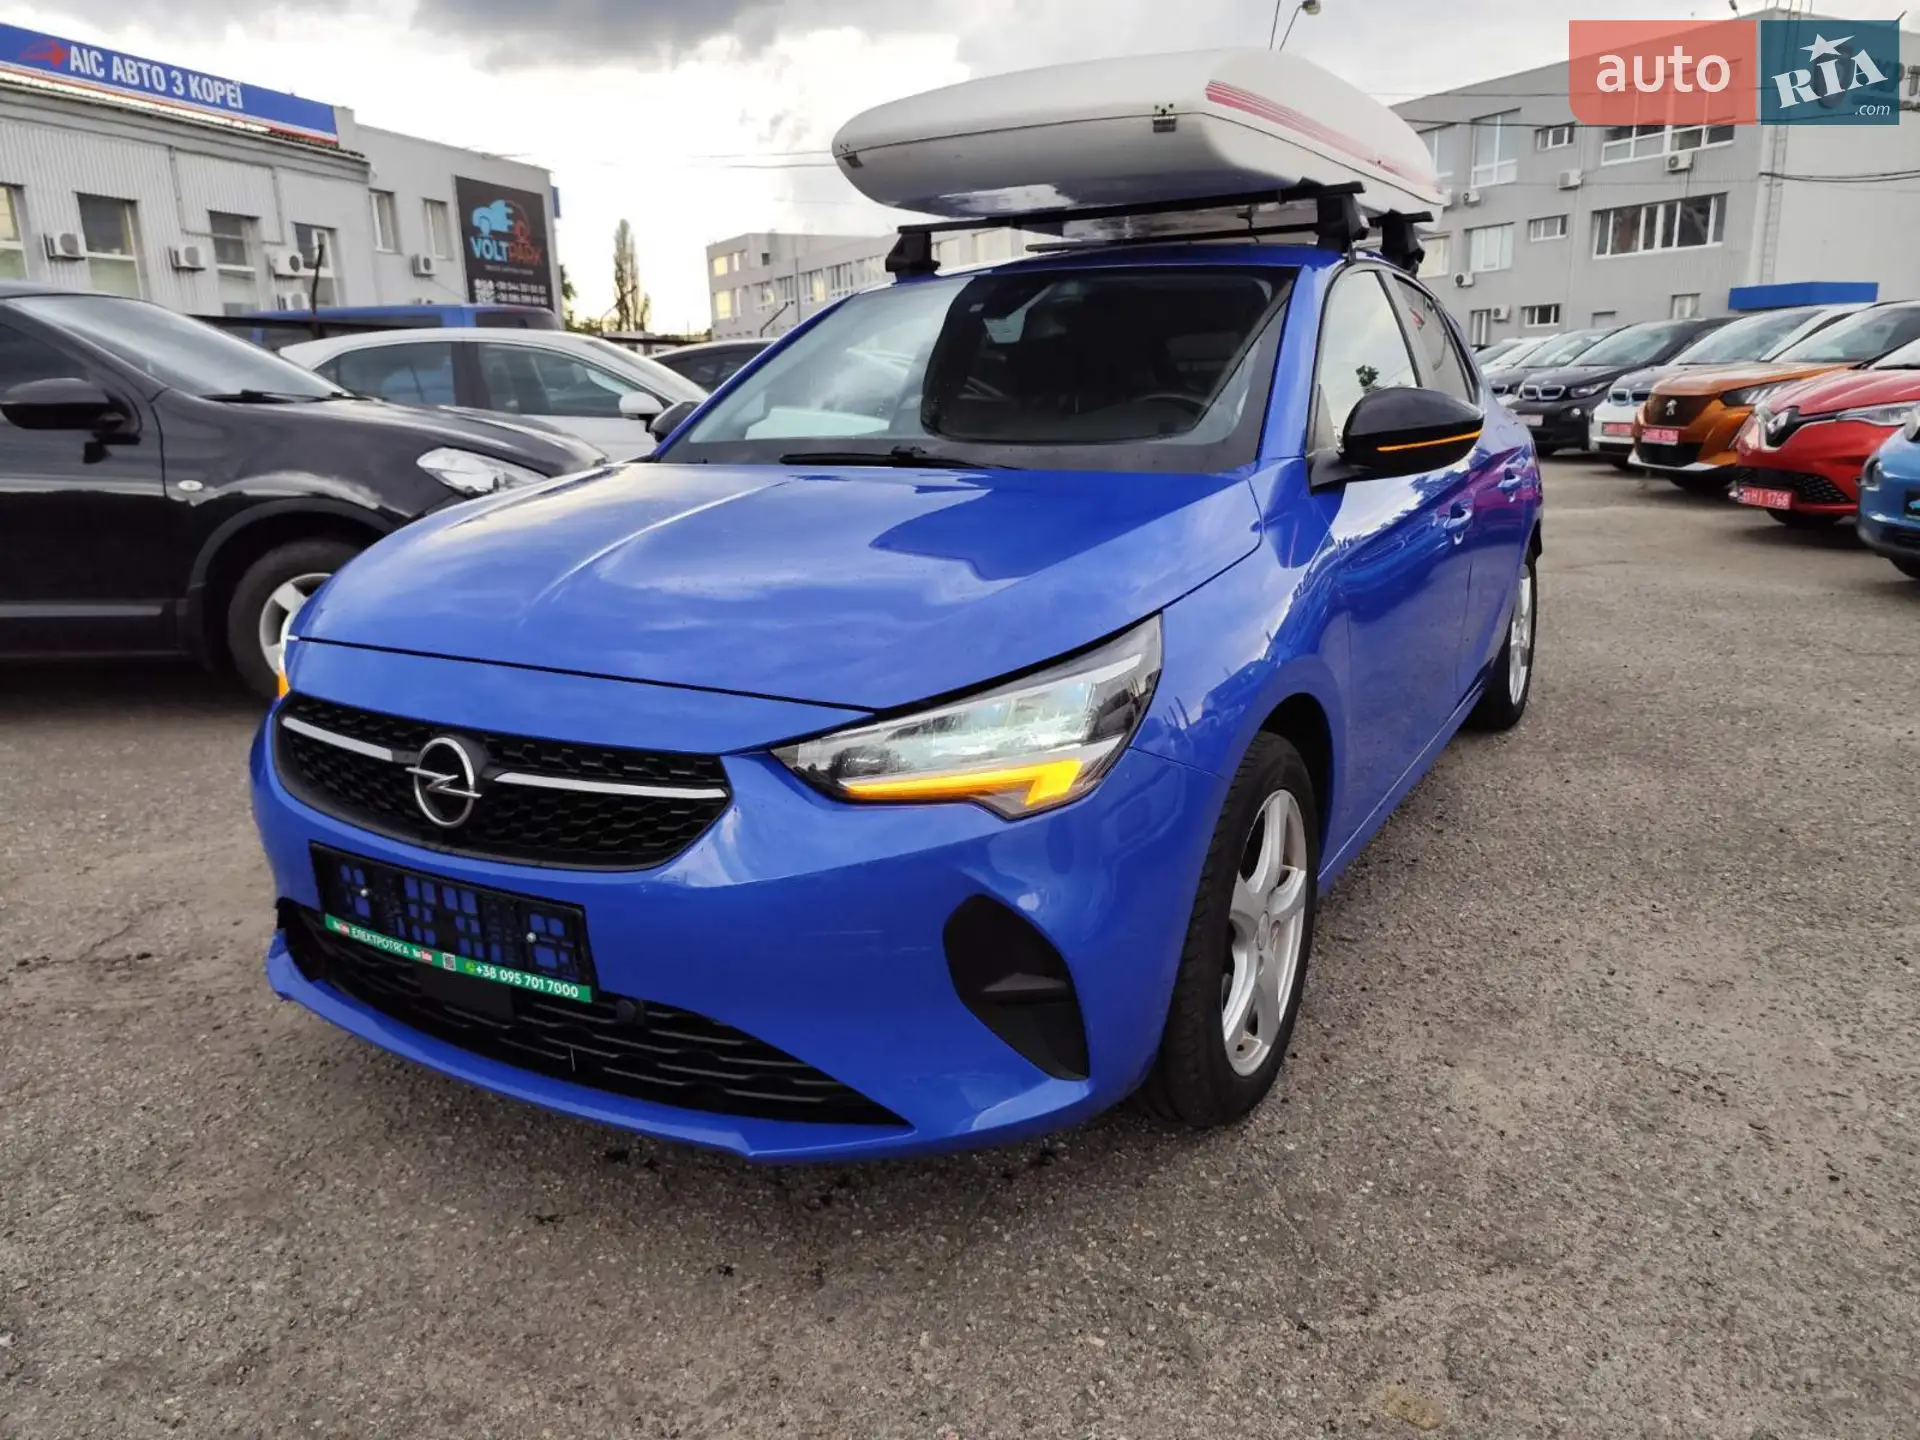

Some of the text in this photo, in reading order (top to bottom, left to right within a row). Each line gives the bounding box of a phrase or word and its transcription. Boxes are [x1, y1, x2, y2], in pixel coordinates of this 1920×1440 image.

[111, 55, 166, 92] АВТО
[189, 77, 244, 110] КОРЕЇ
[476, 965, 497, 979] +38
[499, 969, 522, 985] 095
[525, 975, 544, 990] 701
[547, 982, 579, 998] 7000
